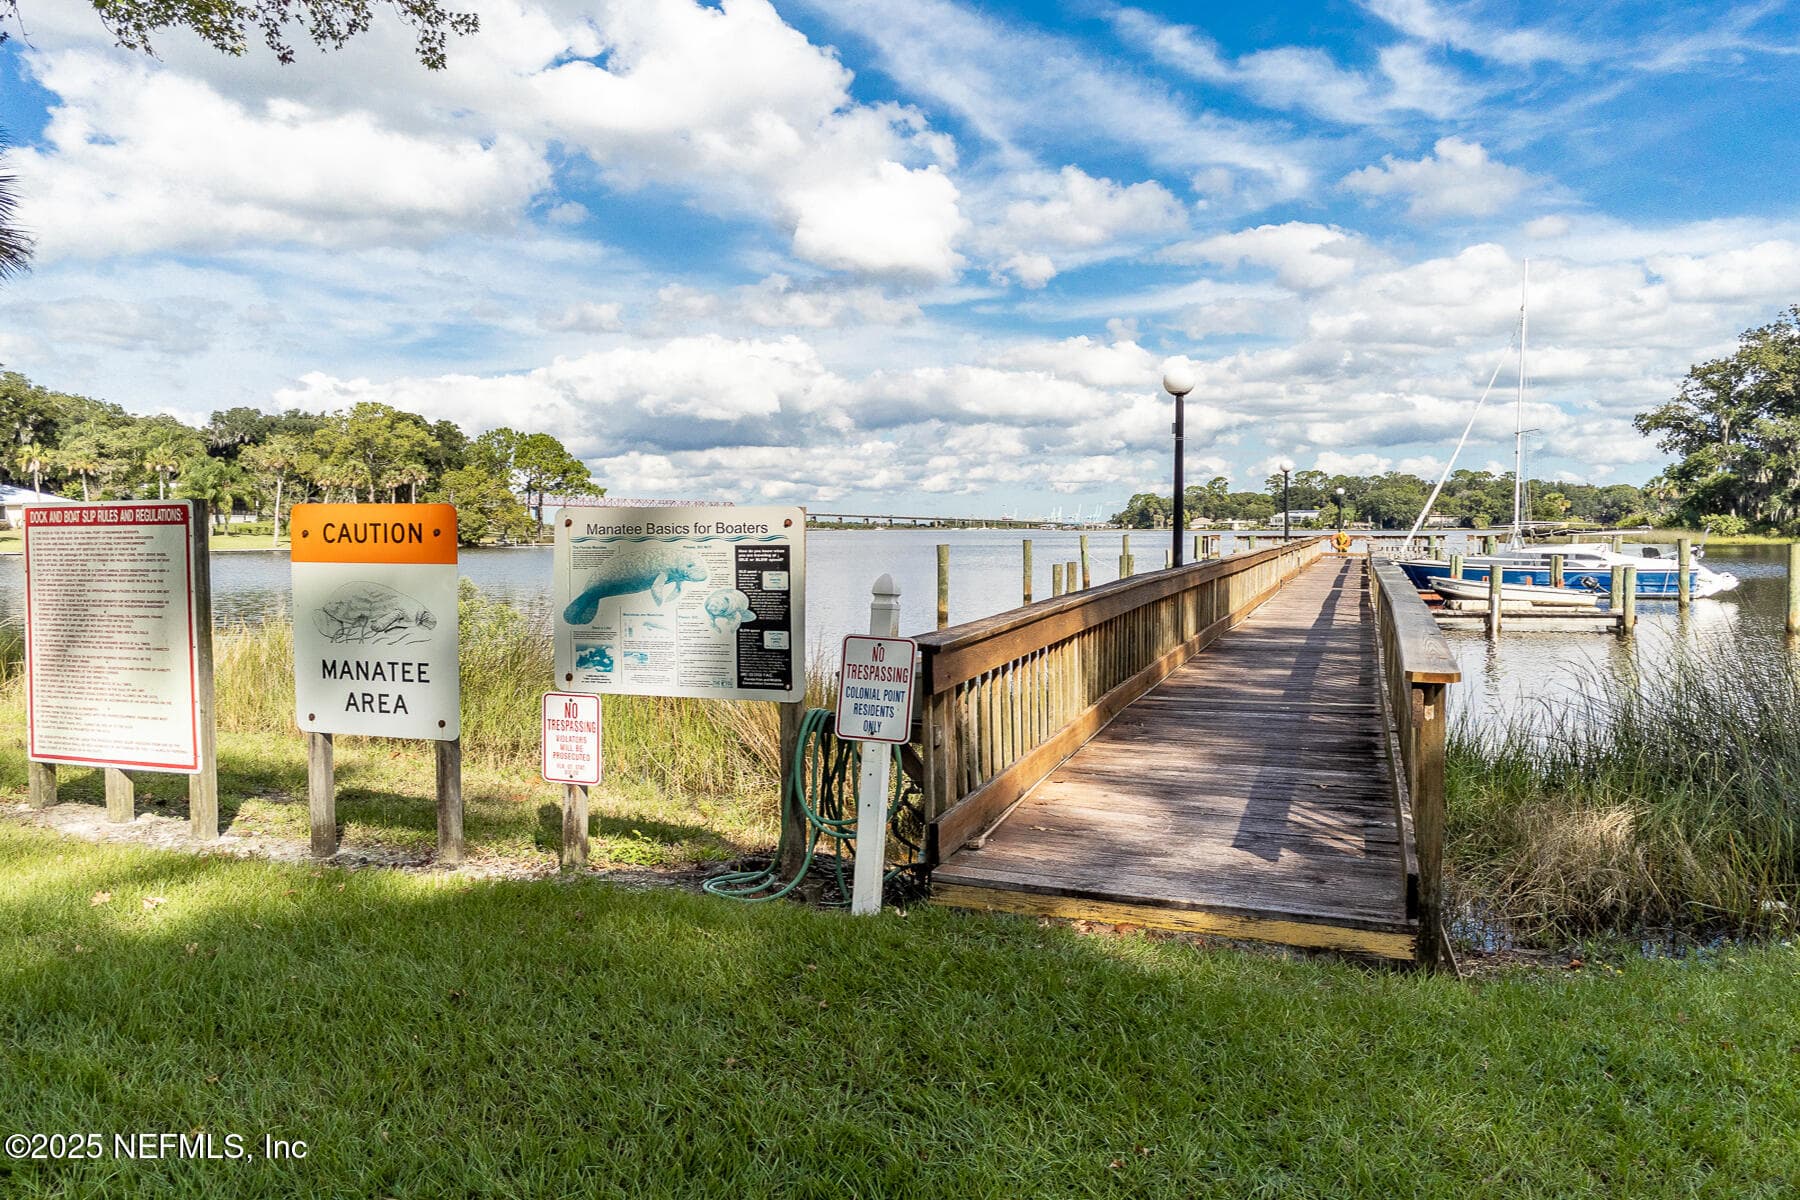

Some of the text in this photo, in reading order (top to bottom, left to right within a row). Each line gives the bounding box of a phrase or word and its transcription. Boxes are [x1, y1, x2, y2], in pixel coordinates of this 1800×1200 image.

[30, 508, 183, 524] DOCK AND BOAT SLIP RULES AND REGULATIONS:
[322, 523, 422, 544] CAUTION
[586, 522, 768, 535] Manatee Basics for Boaters
[872, 646, 885, 662] NO
[321, 658, 430, 684] MANATEE
[846, 664, 909, 683] TRESPASSING
[845, 686, 906, 703] COLONIAL POINT
[345, 692, 409, 715] AREA
[564, 702, 578, 719] NO
[853, 703, 895, 718] RESIDENTS
[547, 719, 596, 733] TRESPASSING
[863, 720, 882, 733] ONLY
